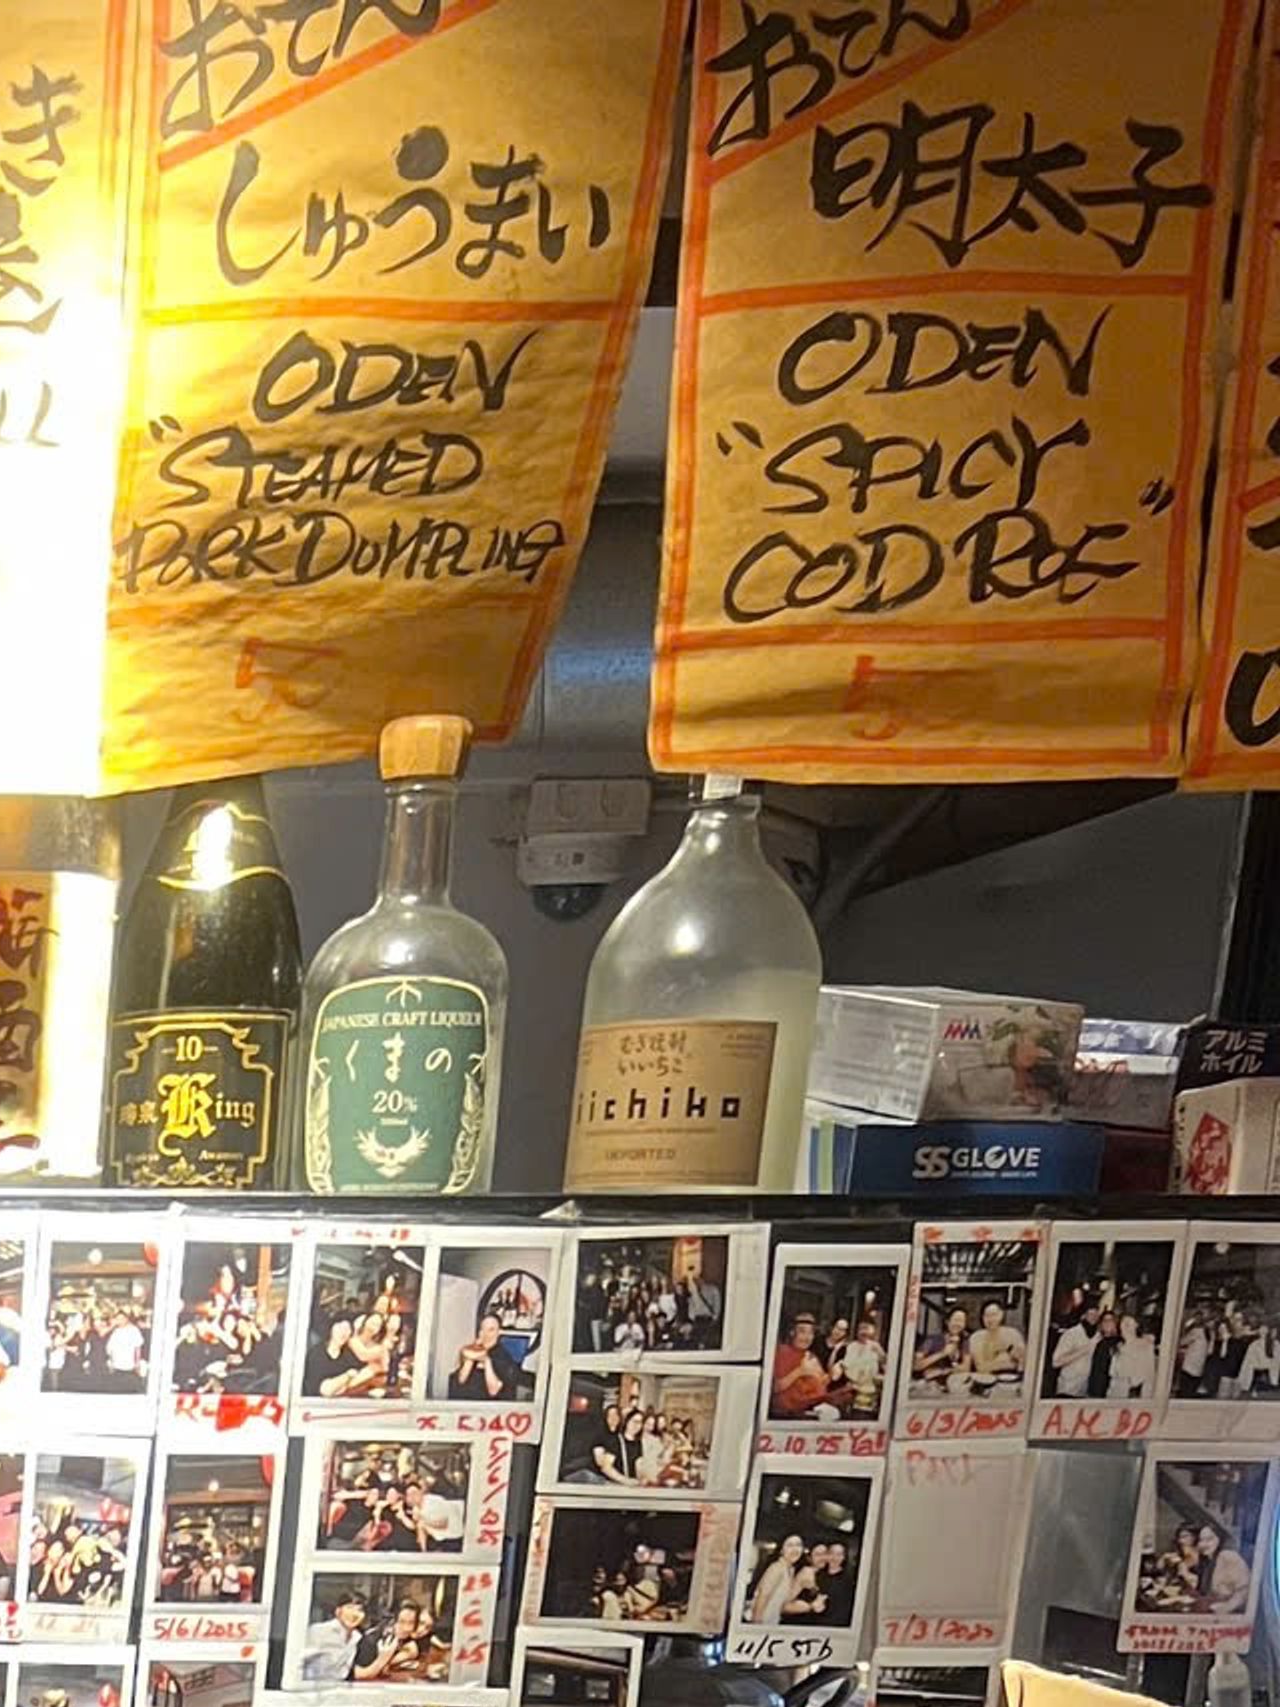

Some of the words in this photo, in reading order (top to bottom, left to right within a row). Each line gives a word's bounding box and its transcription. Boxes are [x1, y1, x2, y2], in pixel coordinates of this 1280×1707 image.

[216, 125, 611, 285] しゅうまい
[811, 101, 1215, 269] 明太子
[251, 330, 540, 423] ODEN
[778, 303, 1113, 405] ODEN
[114, 521, 284, 593] PORK
[278, 509, 565, 585] DUMPLING
[723, 523, 945, 624] COD
[175, 1036, 202, 1061] 10
[382, 1010, 427, 1026] CRAFT
[1204, 1030, 1268, 1051] アルミ
[1199, 1053, 1263, 1074] ホイル
[576, 1086, 740, 1125] iichiko
[951, 1146, 1040, 1170] GLOVE
